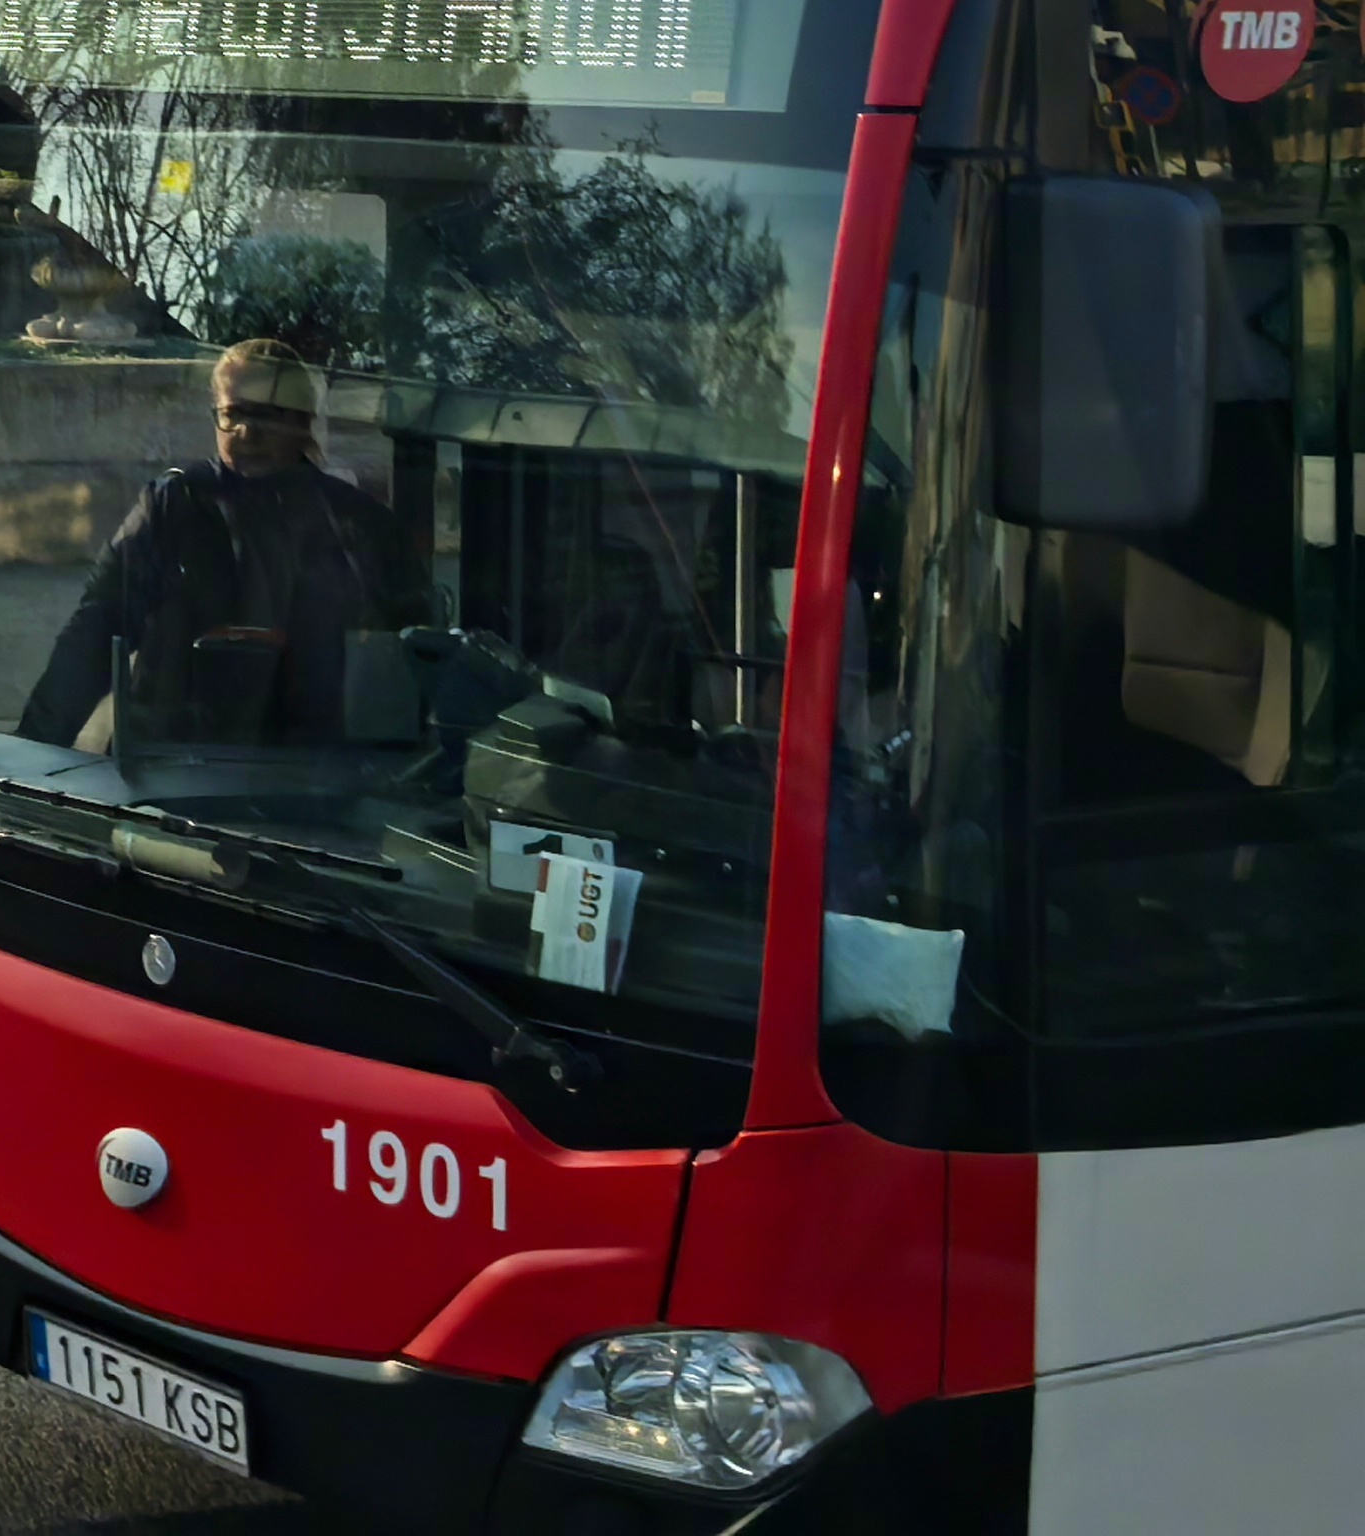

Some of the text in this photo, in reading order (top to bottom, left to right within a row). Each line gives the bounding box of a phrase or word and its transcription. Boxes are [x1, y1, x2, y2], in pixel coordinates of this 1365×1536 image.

[1220, 11, 1301, 50] TMB
[579, 867, 604, 920] UGT
[105, 1154, 152, 1188] TMB
[321, 1119, 508, 1231] 1901
[58, 1335, 241, 1454] 1151 KSB
